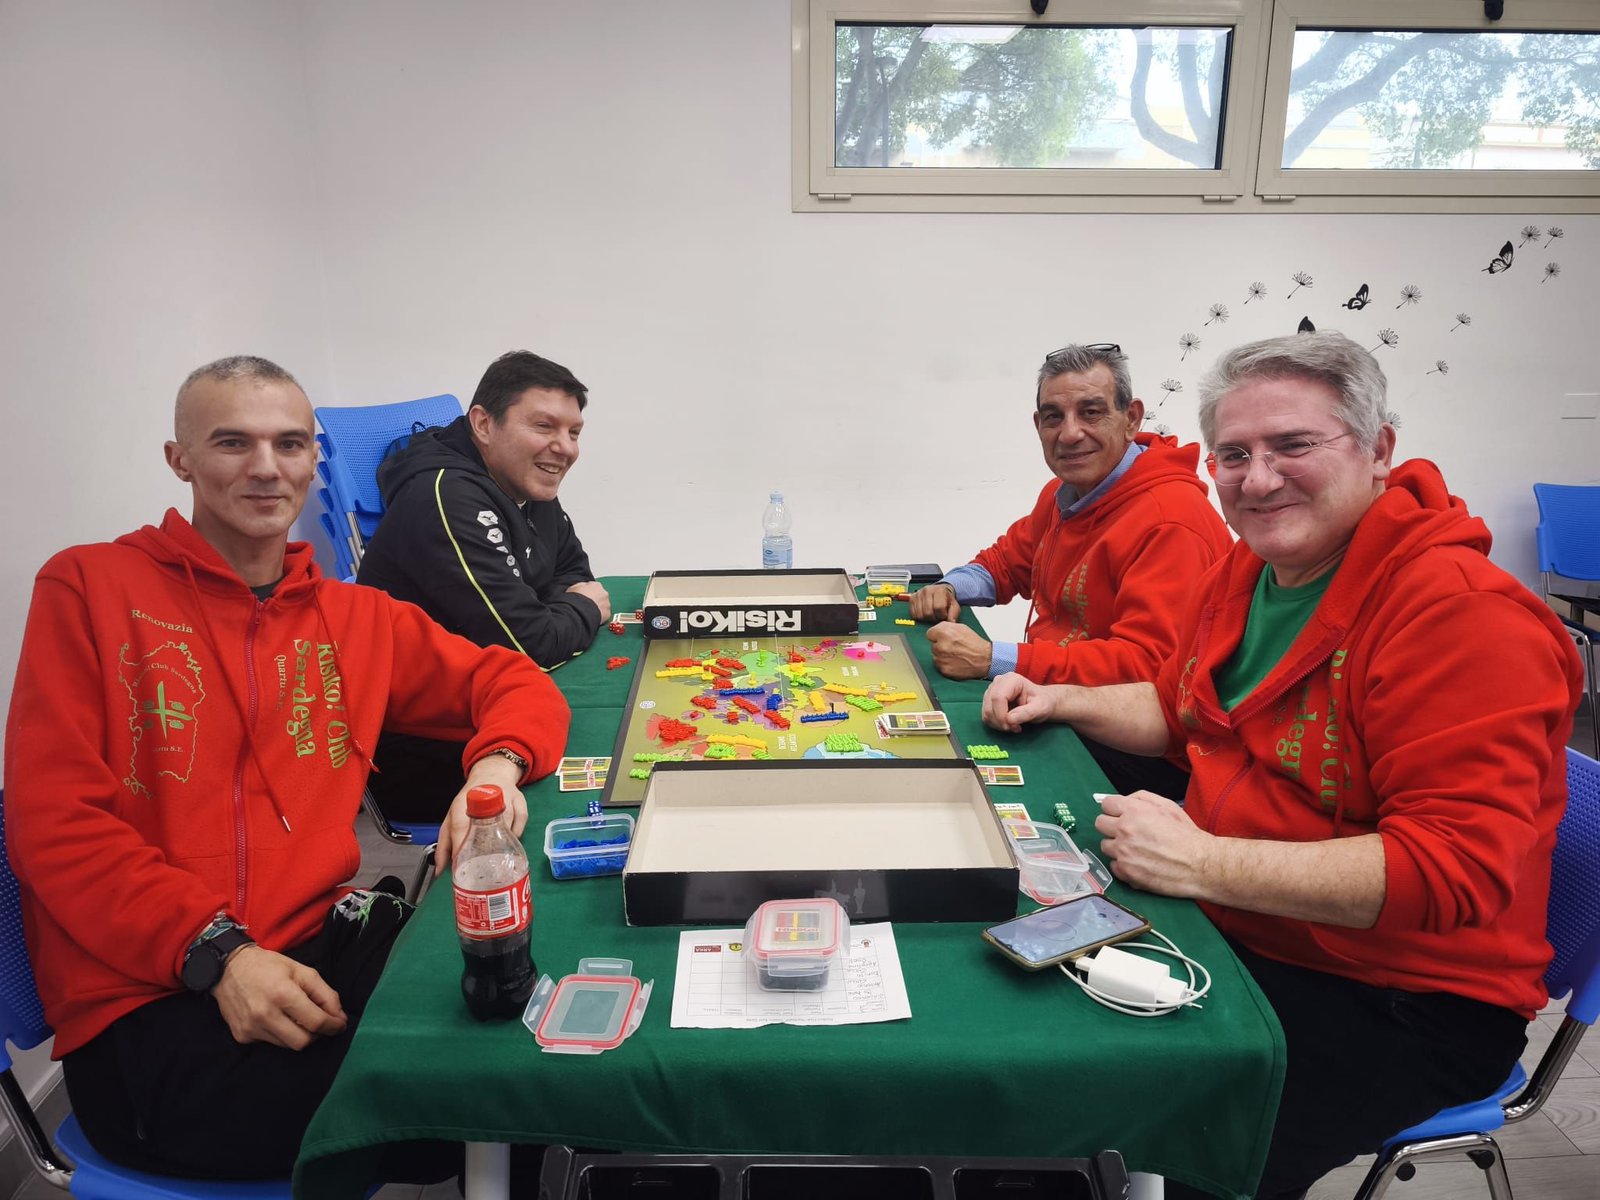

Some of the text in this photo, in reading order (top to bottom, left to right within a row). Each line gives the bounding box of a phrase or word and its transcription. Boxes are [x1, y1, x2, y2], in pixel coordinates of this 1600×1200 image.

[131, 609, 193, 634] Renovazia
[678, 609, 802, 633] RisiKo!
[151, 662, 169, 670] Club
[286, 638, 317, 758] Sardegna
[327, 719, 352, 769] Club
